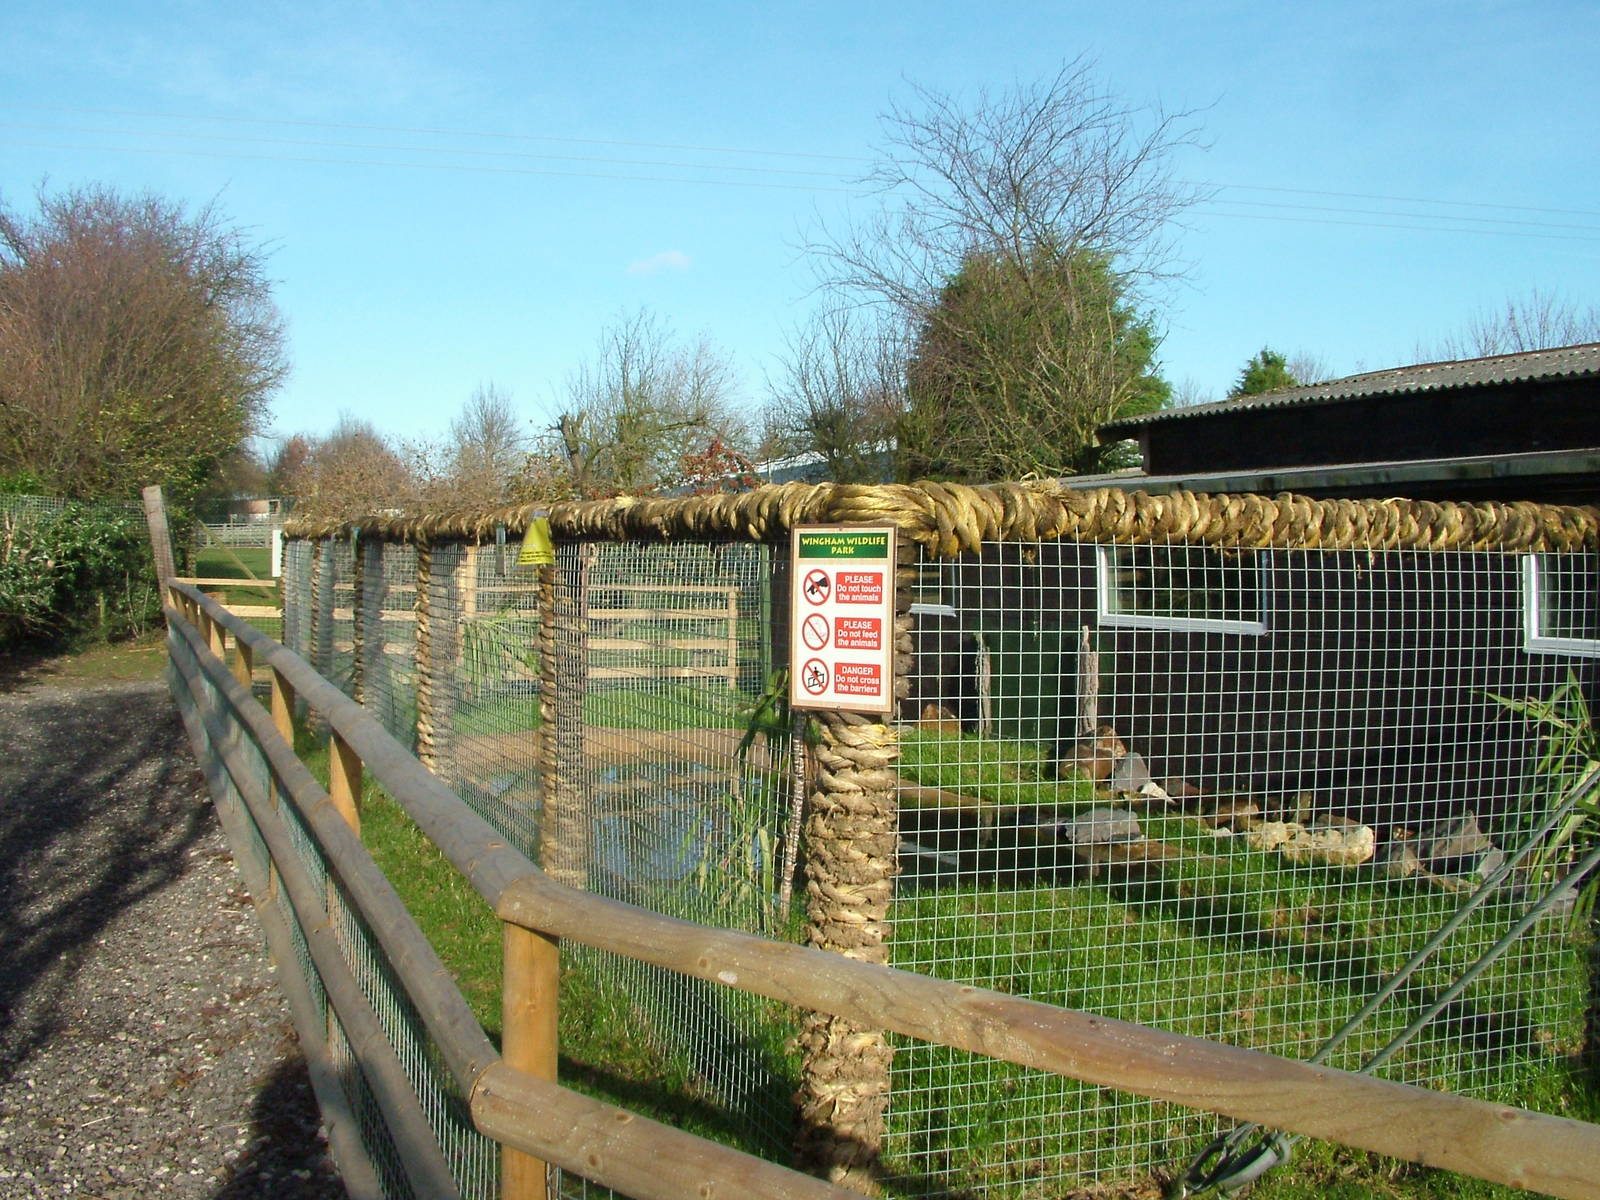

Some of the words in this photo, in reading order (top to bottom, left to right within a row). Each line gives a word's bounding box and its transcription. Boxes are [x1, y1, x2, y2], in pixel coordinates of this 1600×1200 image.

[802, 537, 845, 545] WINGHAM
[846, 537, 886, 545] WILDLIFE
[844, 576, 874, 584] PLEASE
[836, 584, 847, 592] Do
[861, 584, 881, 592] touch
[838, 592, 850, 600] the
[851, 593, 878, 601] animals
[844, 620, 872, 629] PLEASE
[838, 629, 848, 637] Do
[862, 630, 878, 638] feed
[838, 638, 849, 646] the
[850, 639, 877, 647] animals
[842, 666, 873, 675] DANGER
[850, 684, 877, 692] barriers
